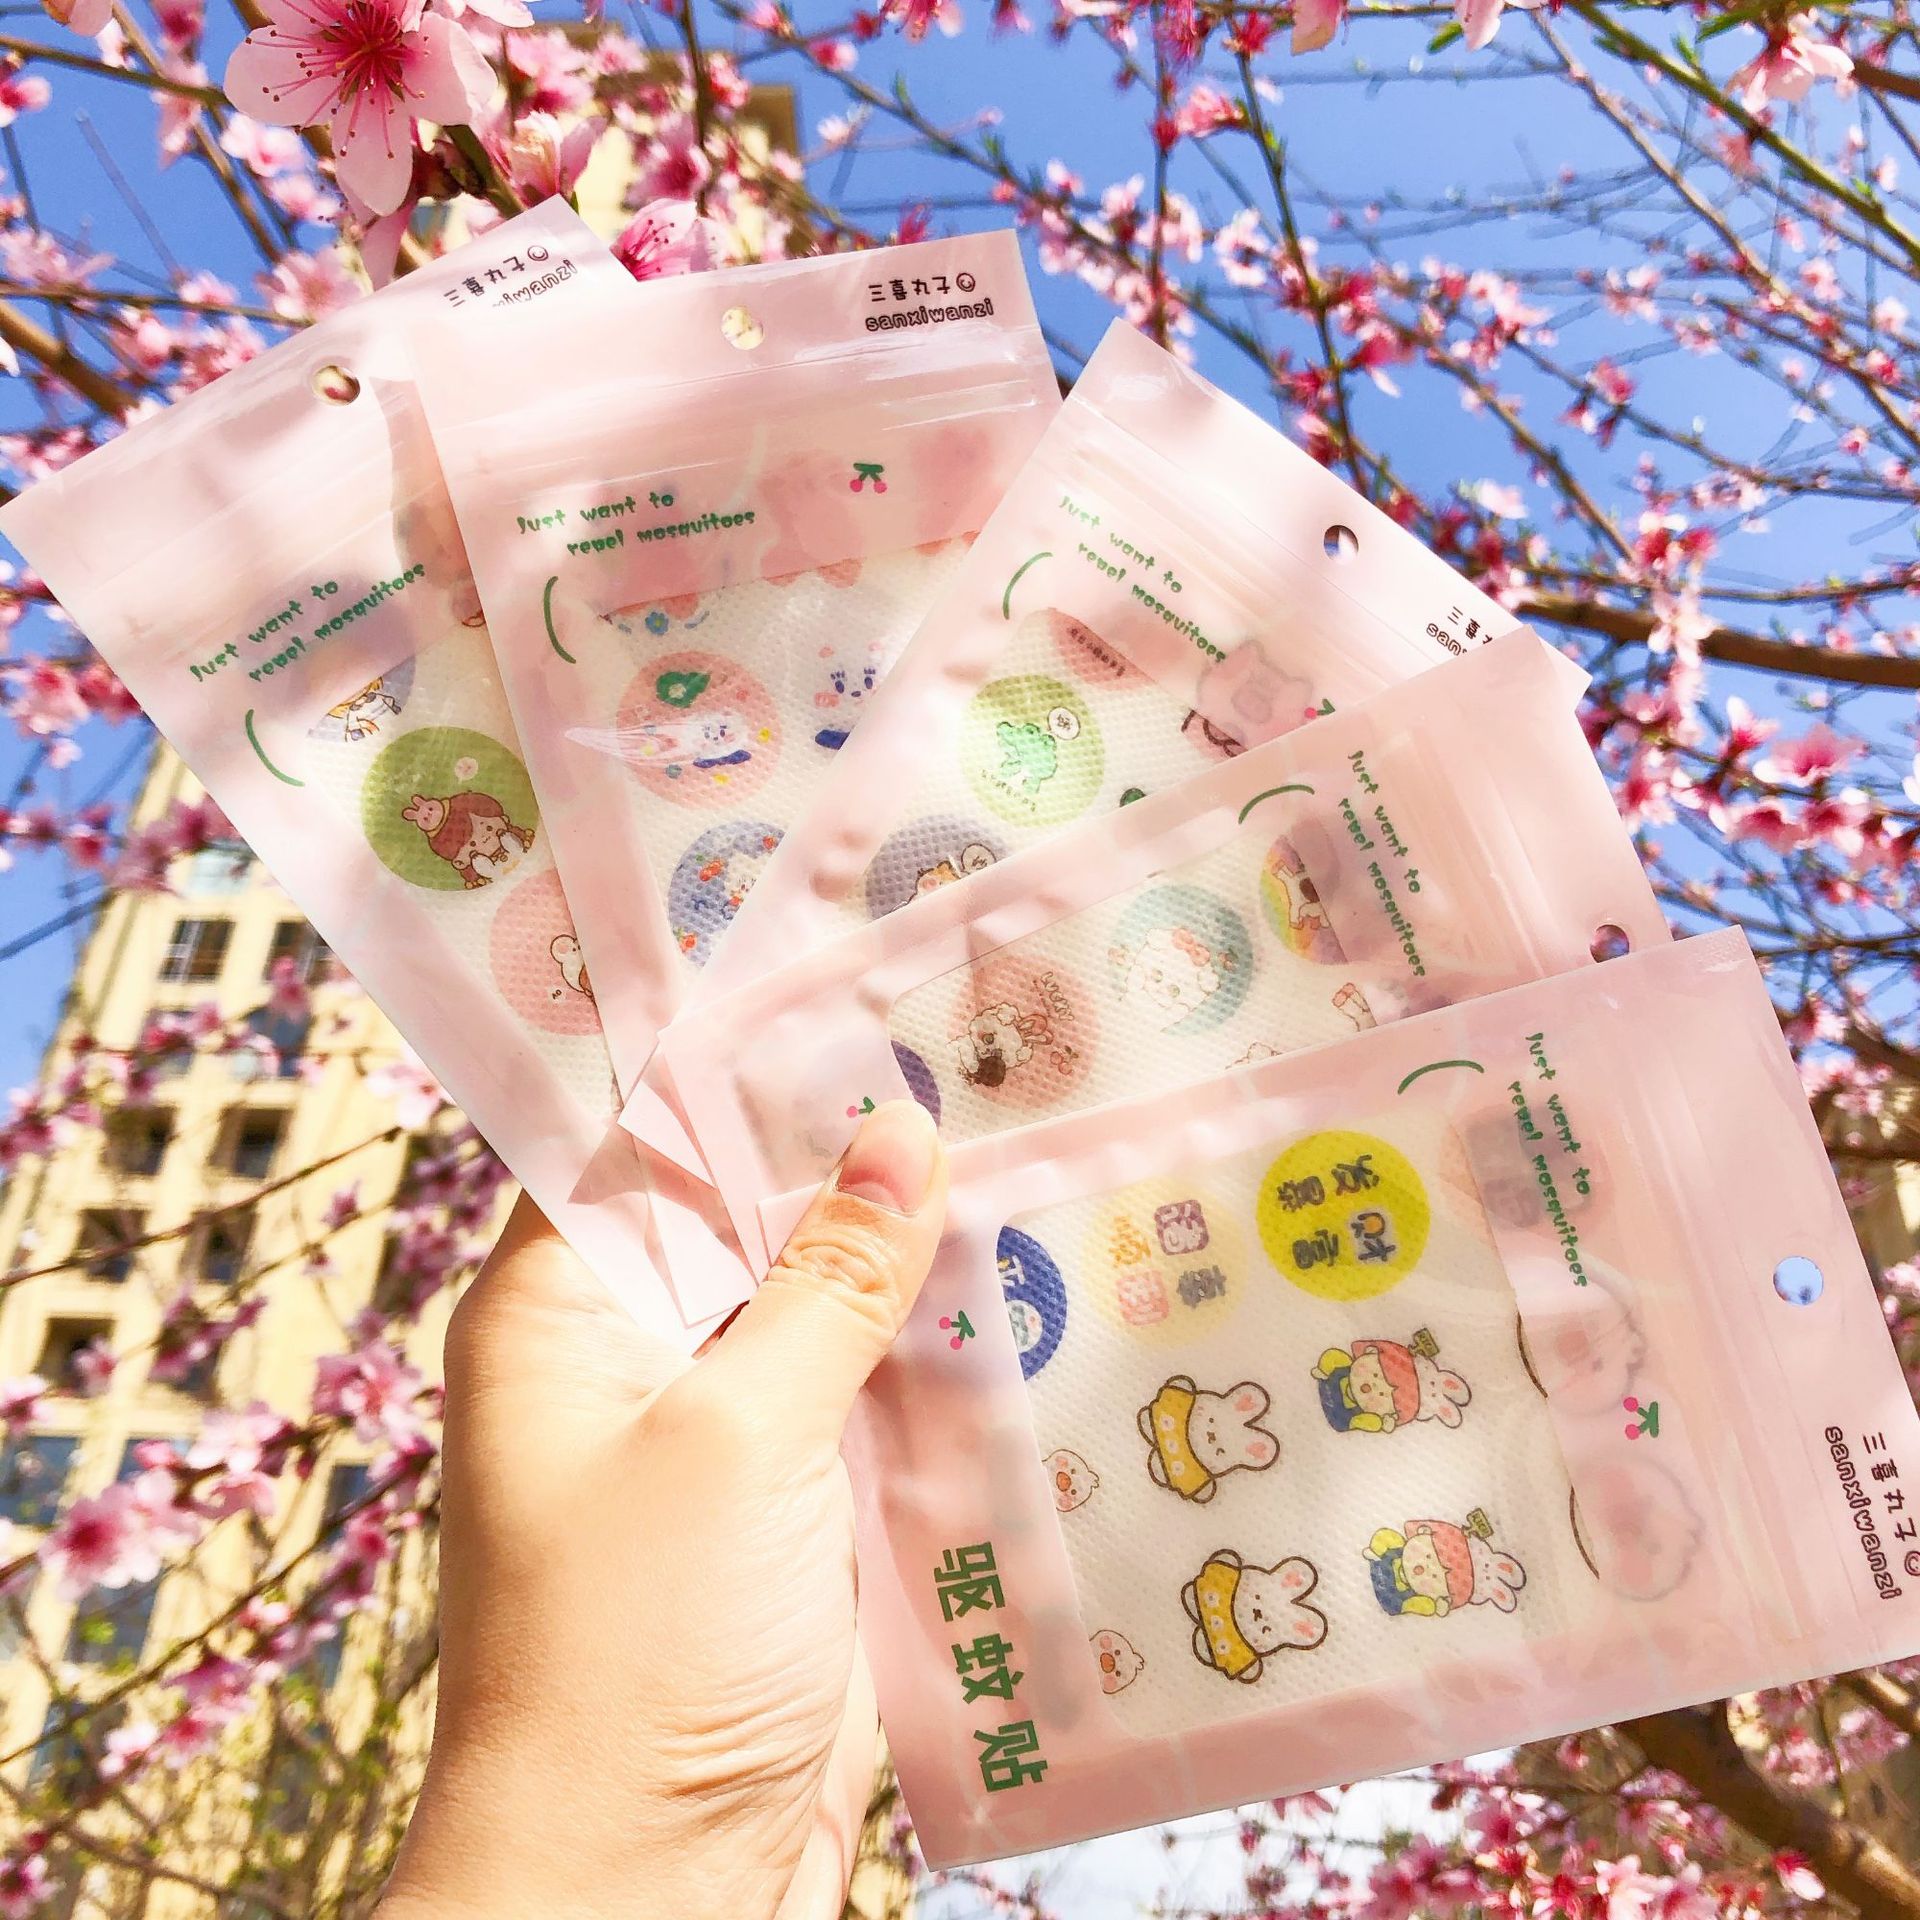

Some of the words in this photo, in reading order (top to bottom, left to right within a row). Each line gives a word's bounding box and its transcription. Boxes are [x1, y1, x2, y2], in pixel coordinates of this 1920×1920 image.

[443, 255, 526, 307] 三喜丸子
[865, 297, 995, 331] sanxiwanzi
[868, 276, 950, 301] 三喜丸子
[567, 528, 624, 556] repel
[637, 510, 756, 543] mosquitoes
[579, 495, 637, 521] want
[648, 492, 674, 509] to
[1078, 542, 1127, 583] repel
[1131, 584, 1227, 664] mosquitoes
[1109, 532, 1155, 570] want
[1163, 570, 1183, 594] to
[248, 600, 304, 643] want
[310, 580, 339, 601] to
[248, 636, 307, 683] repel
[314, 563, 426, 641] mosquitoes
[1425, 623, 1468, 656] san
[1338, 798, 1375, 851] repel
[1367, 861, 1427, 977] mosquitoes
[1374, 805, 1409, 857] want
[1403, 868, 1421, 894] to
[1507, 1080, 1544, 1141] repel
[1531, 1154, 1588, 1288] mosquitoes
[1546, 1093, 1582, 1153] want
[1571, 1167, 1591, 1195] to
[1824, 1425, 1903, 1601] sanxiwanzi
[1862, 1432, 1918, 1543] 三喜丸子
[933, 1541, 1049, 1793] 驱蚊贴
